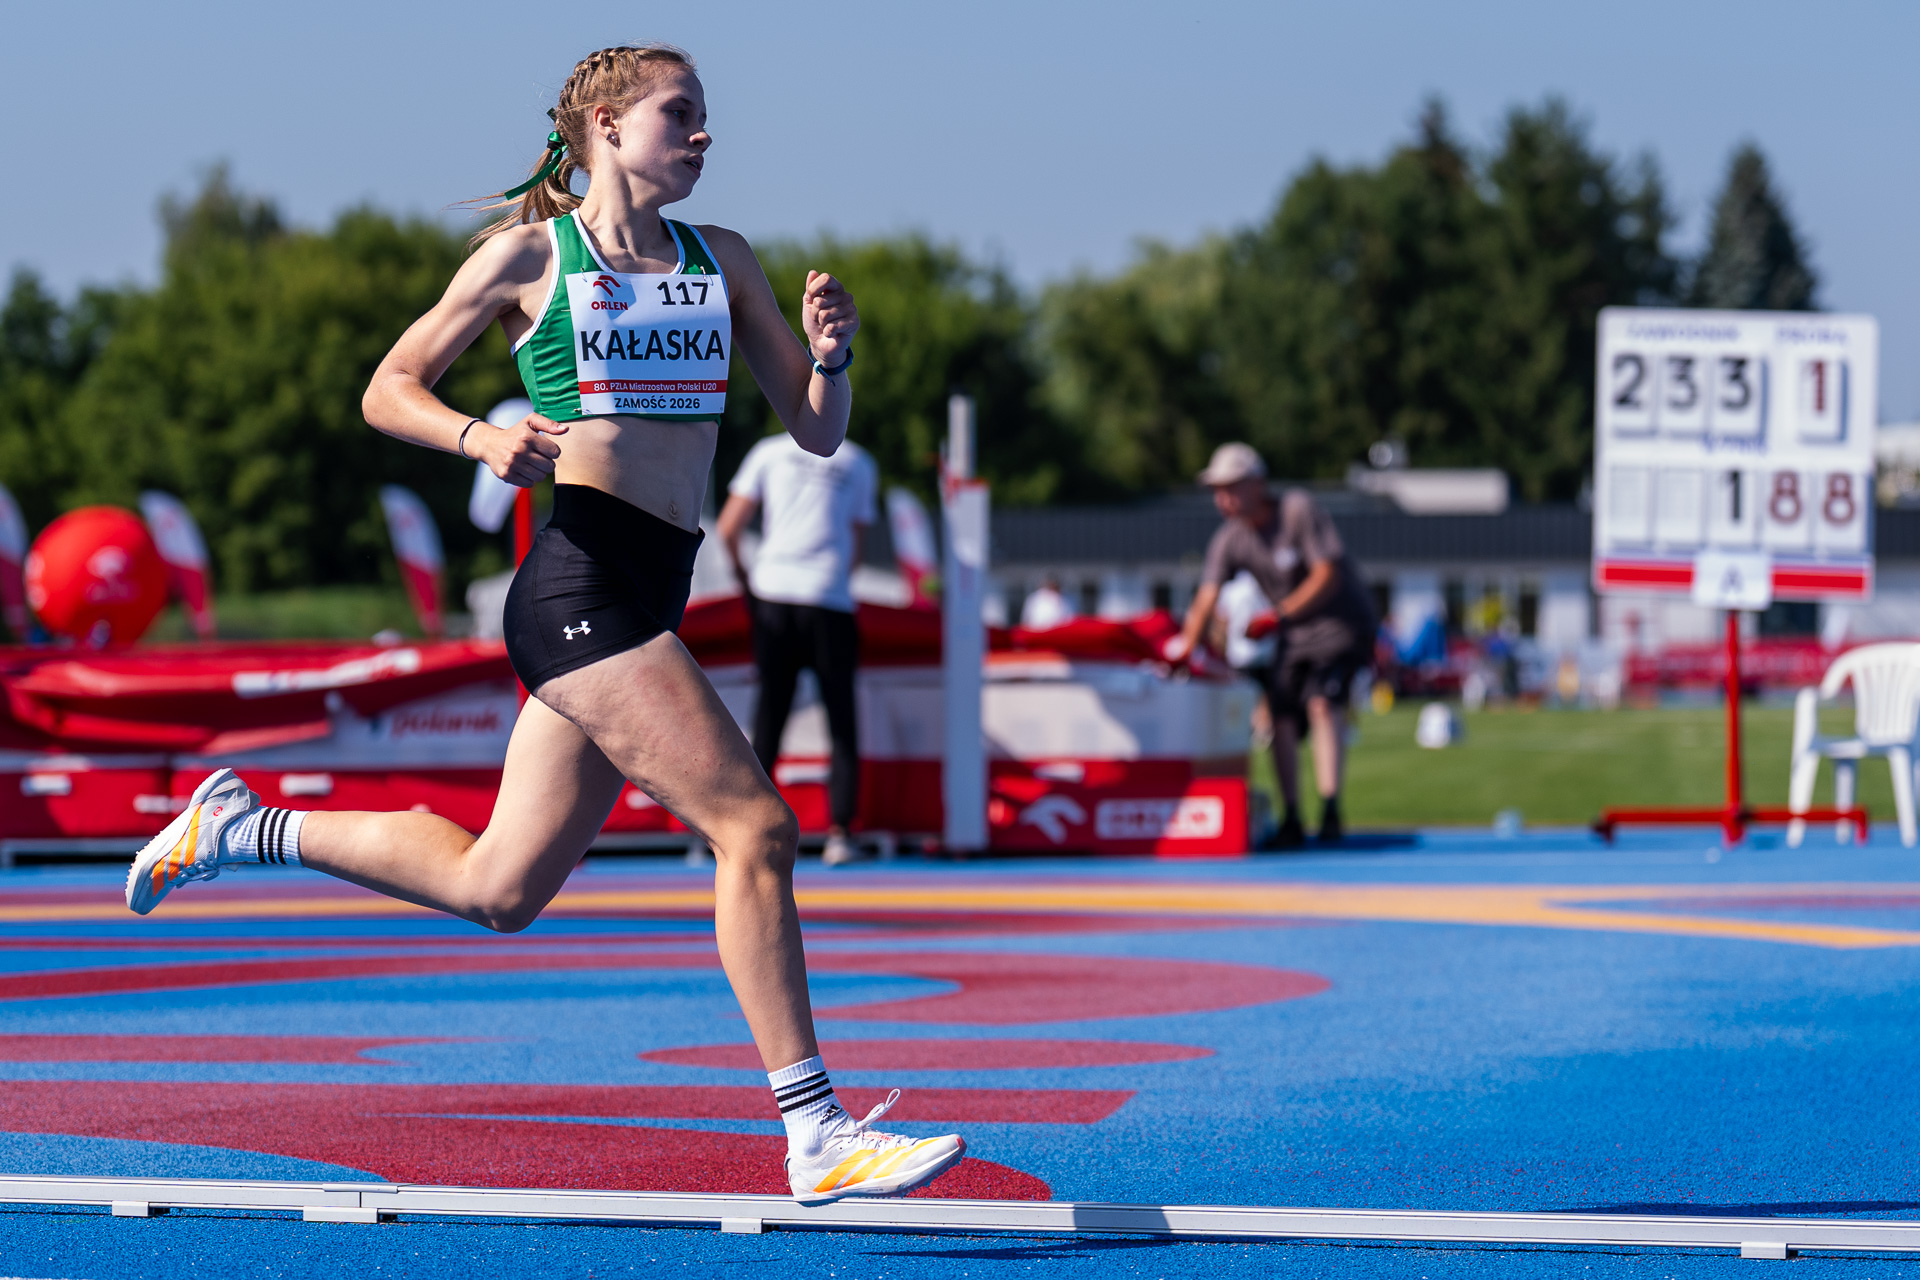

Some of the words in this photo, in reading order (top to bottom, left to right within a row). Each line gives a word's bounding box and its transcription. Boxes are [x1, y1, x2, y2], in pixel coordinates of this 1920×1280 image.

[591, 301, 629, 311] ORLEN
[657, 281, 709, 306] 117
[580, 329, 725, 362] KAŁASKA
[593, 383, 609, 392] 80.
[610, 382, 629, 391] PZLA
[629, 382, 676, 392] Mistrzostwa
[677, 382, 701, 392] Polski
[702, 382, 717, 391] U20
[1810, 358, 1827, 415] 1
[614, 395, 667, 409] ZAMOŚĆ
[669, 397, 701, 409] 2026
[1720, 565, 1745, 592] A
